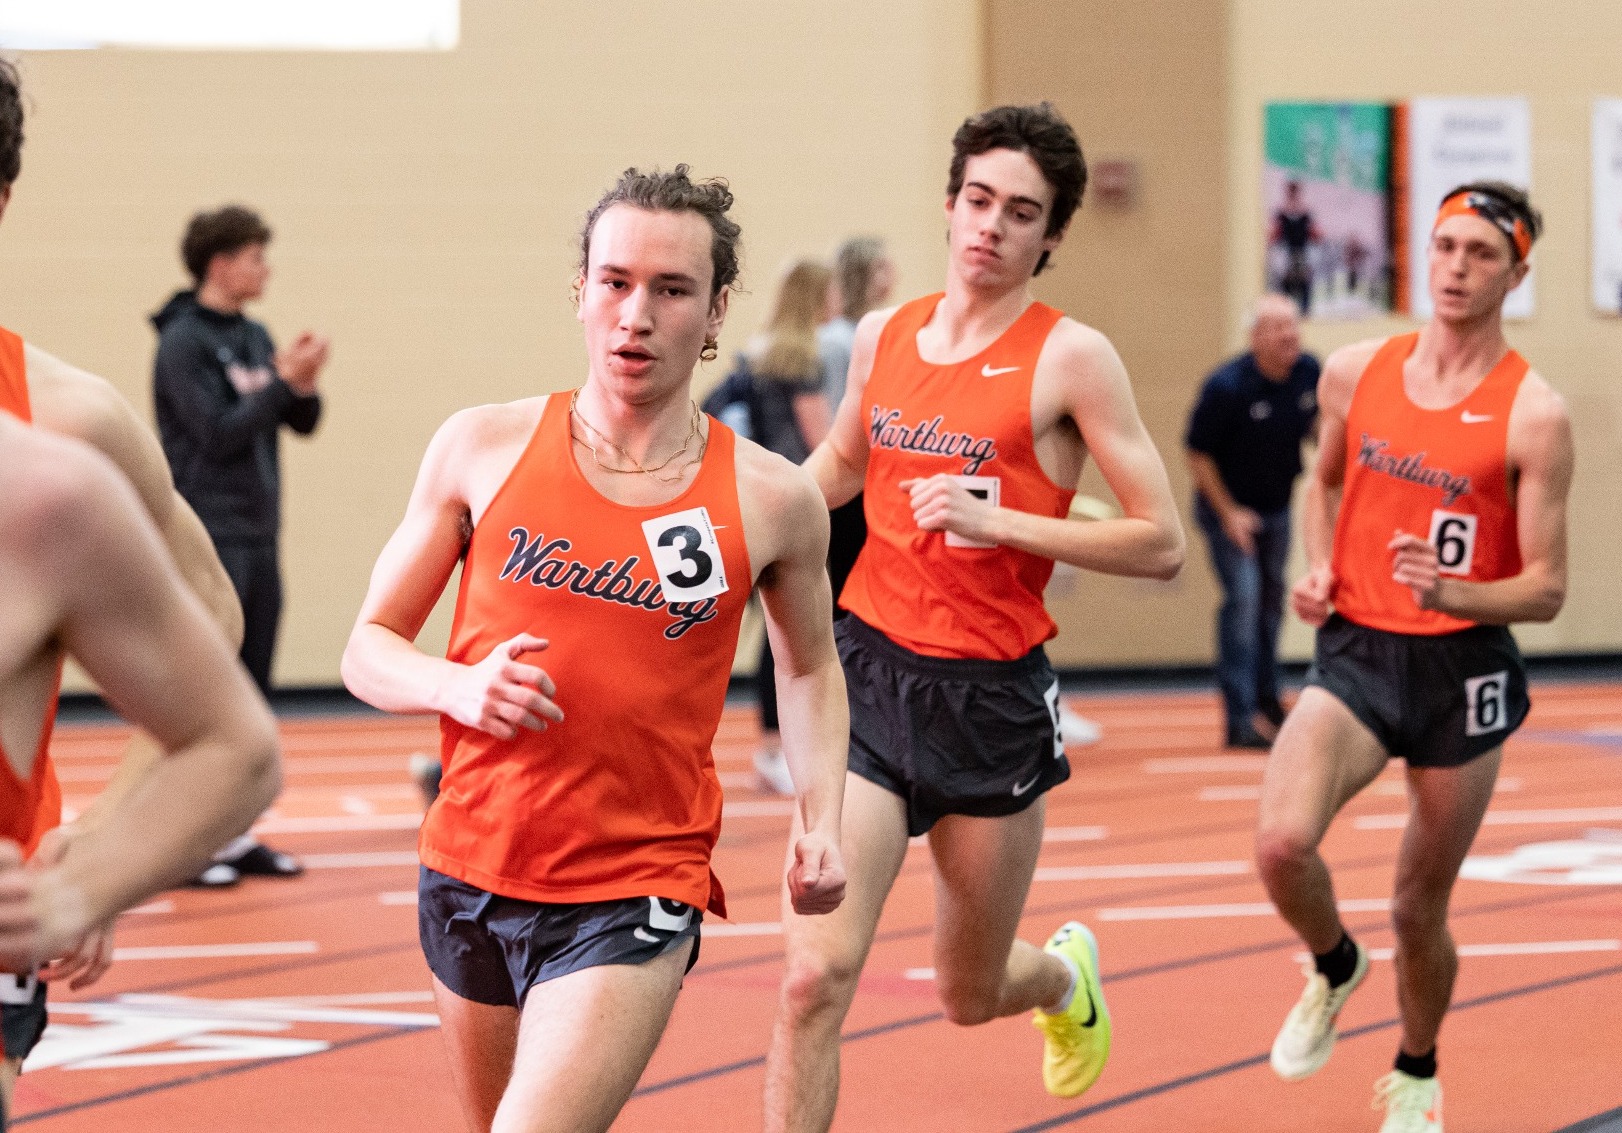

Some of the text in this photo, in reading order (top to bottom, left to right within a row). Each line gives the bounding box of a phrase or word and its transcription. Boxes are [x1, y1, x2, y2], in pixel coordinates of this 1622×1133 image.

[870, 405, 997, 476] Wartburg
[1359, 432, 1472, 506] Wartburg
[657, 525, 713, 588] 3
[1436, 519, 1468, 567] 6
[1476, 681, 1499, 727] 6
